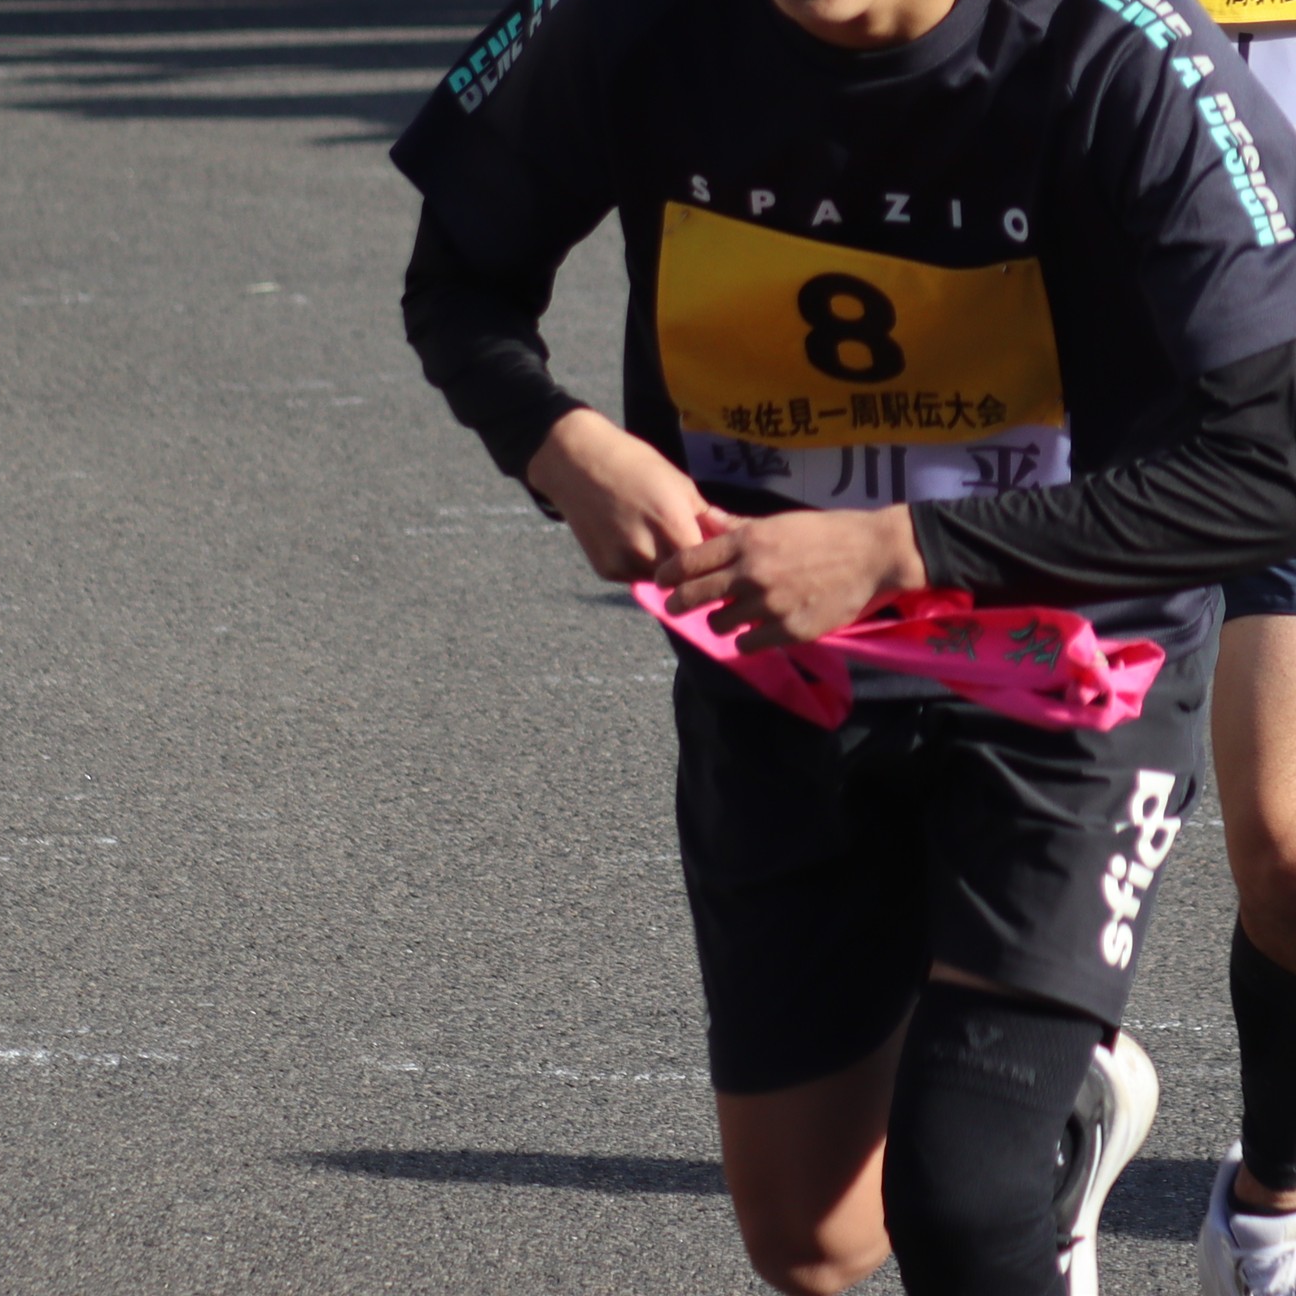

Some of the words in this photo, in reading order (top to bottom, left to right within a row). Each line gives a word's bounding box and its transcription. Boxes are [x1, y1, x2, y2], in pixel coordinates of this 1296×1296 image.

[1170, 54, 1215, 89] A
[1196, 92, 1296, 247] DESIGN
[691, 174, 1030, 242] SPAZIO
[797, 273, 906, 383] 8
[722, 391, 1007, 438] 波佐見一周駅伝大会
[1100, 769, 1182, 971] sfida
